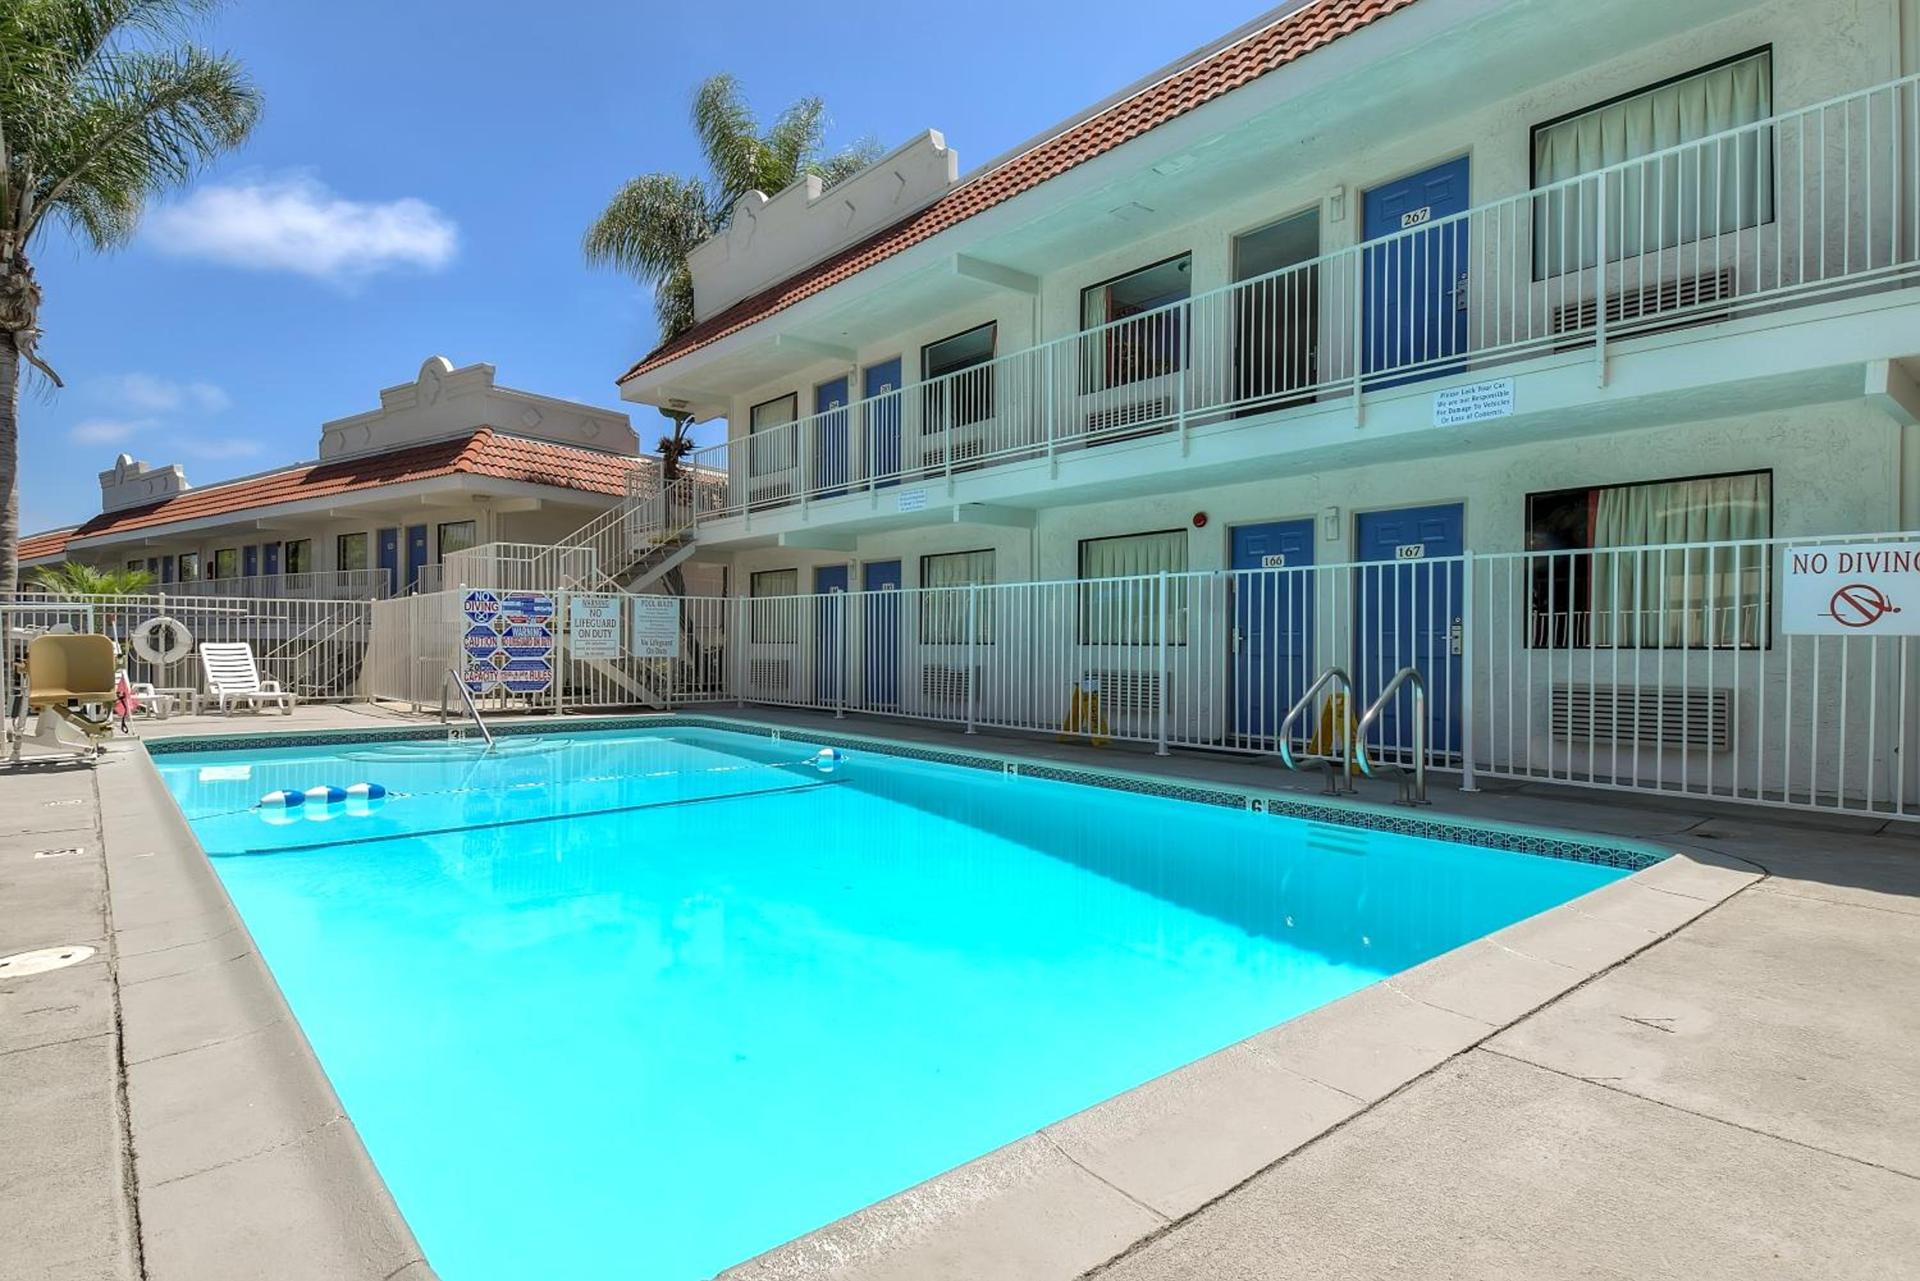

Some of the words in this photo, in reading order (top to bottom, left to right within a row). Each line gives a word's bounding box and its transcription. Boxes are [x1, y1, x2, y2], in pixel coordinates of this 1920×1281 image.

[1404, 208, 1428, 226] 267
[1461, 386, 1475, 395] Lock
[1493, 382, 1505, 390] Car
[1471, 390, 1510, 401] Responsible
[1448, 405, 1472, 415] Damage
[1482, 399, 1510, 408] Vehicles
[1450, 415, 1465, 423] Loss
[1398, 546, 1421, 559] 167
[1264, 556, 1283, 567] 166
[1792, 553, 1828, 575] NO
[474, 591, 490, 601] NO
[464, 602, 499, 611] DIVING
[589, 609, 602, 618] NO
[574, 619, 617, 628] LIFEGUARD
[512, 626, 543, 637] WARNING
[578, 630, 592, 639] ON
[592, 630, 613, 639] DUTY
[463, 636, 499, 647] CAUTION
[464, 671, 499, 682] CAPACITY
[529, 670, 552, 681] RULES
[1251, 799, 1263, 813] 6
